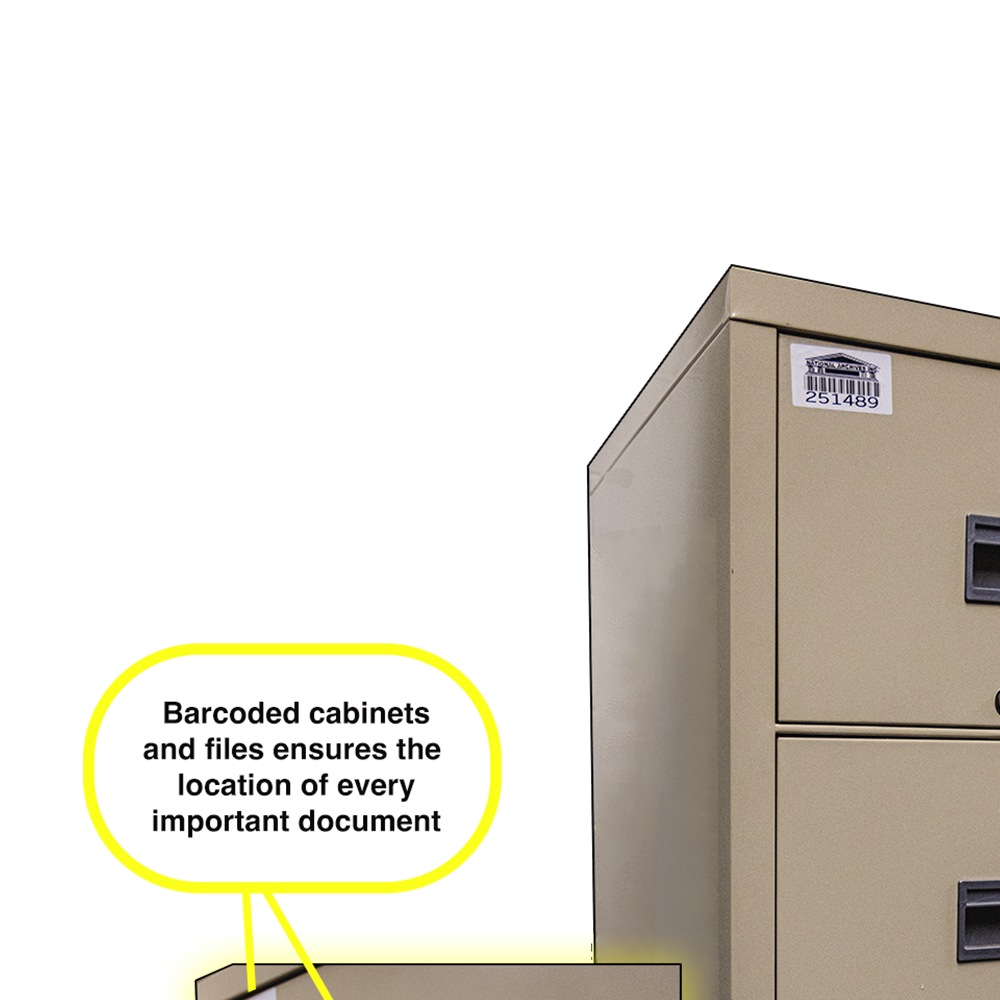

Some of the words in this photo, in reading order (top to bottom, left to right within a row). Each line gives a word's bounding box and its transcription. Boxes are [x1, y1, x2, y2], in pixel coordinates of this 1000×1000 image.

[806, 360, 836, 369] NATIONAL
[837, 363, 866, 372] ARCHIVES
[805, 390, 879, 409] 251489
